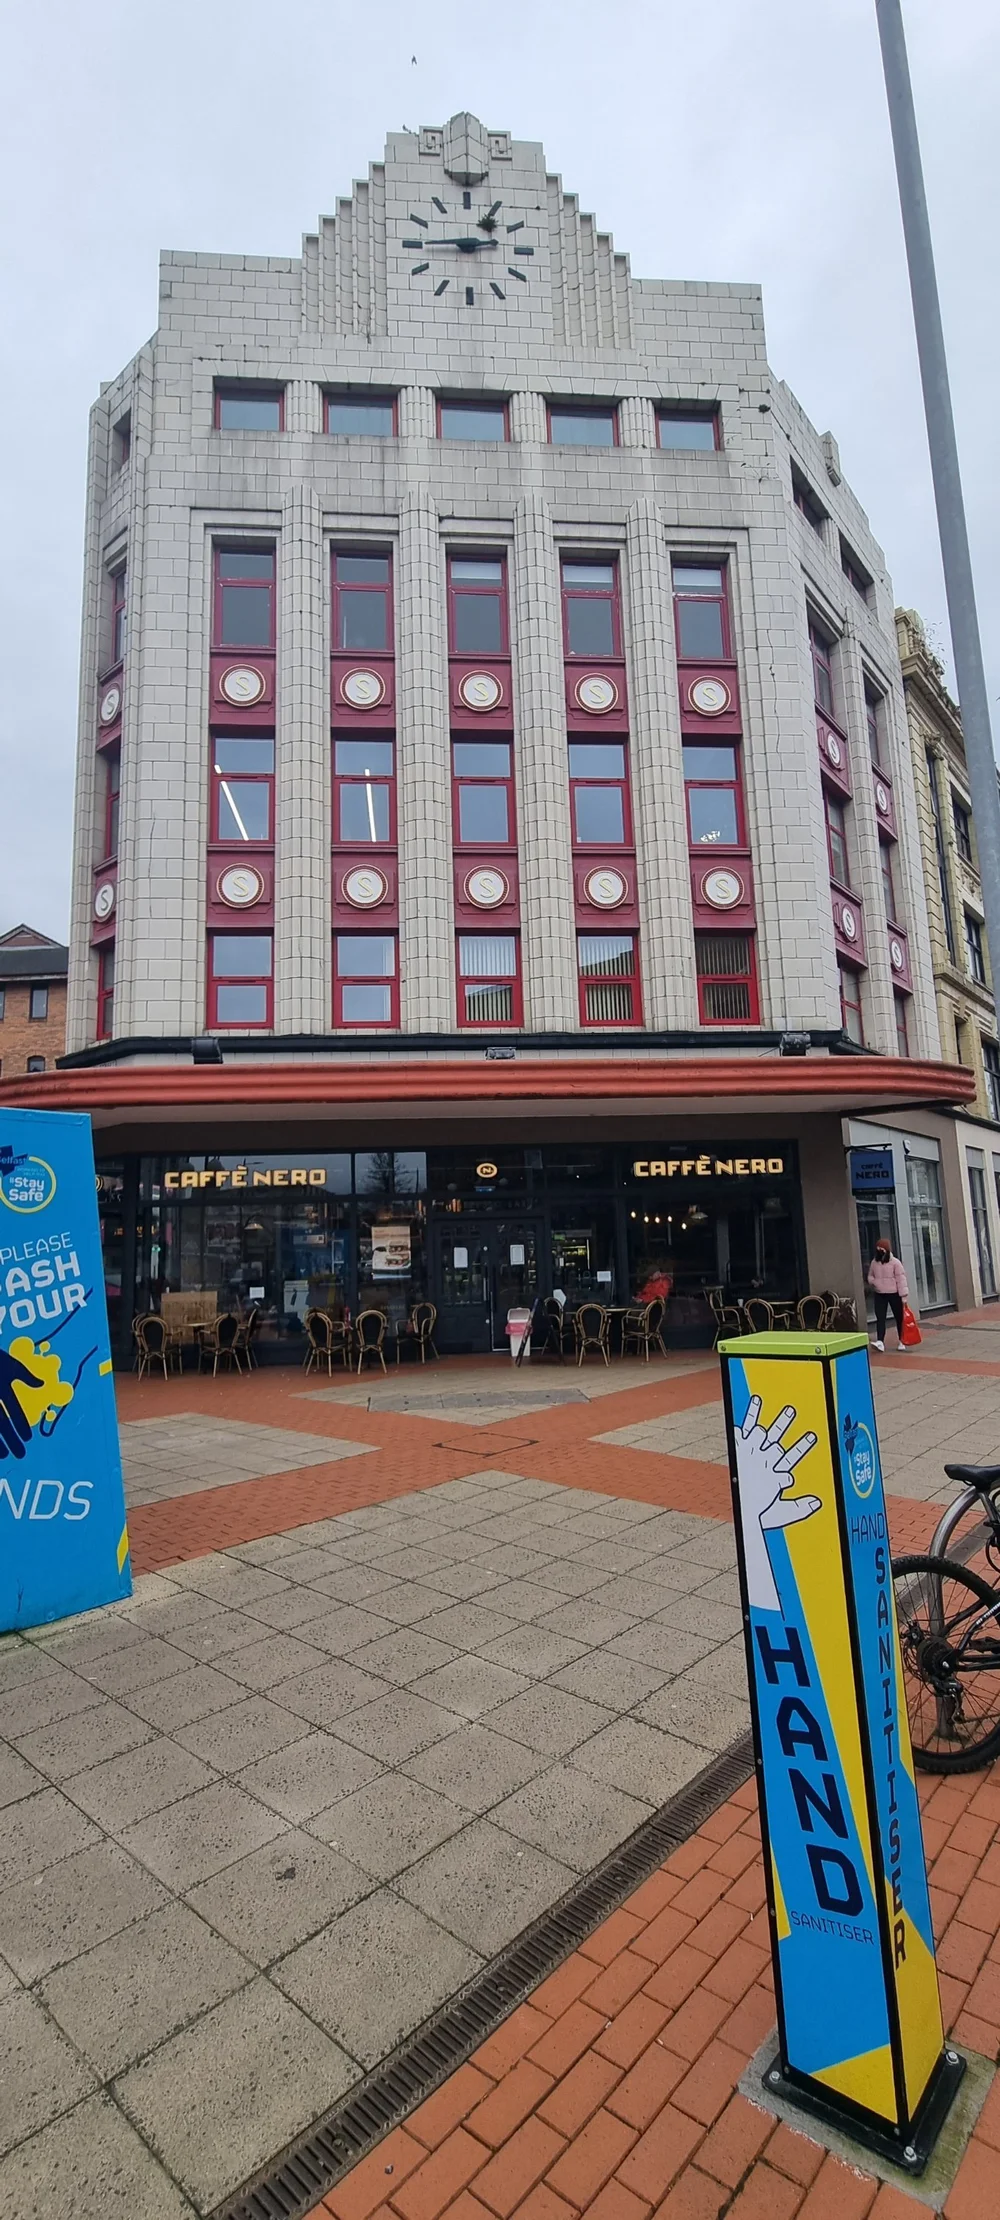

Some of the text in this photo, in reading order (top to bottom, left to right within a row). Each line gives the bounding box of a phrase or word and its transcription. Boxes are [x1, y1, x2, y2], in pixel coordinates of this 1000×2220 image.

[0, 1155, 26, 1165] elfast
[634, 1155, 783, 1177] CAFFÈ NERO
[164, 1165, 327, 1188] CAFFÈ NERO
[856, 1170, 889, 1179] NERO
[9, 1189, 43, 1202] Safe
[0, 1232, 73, 1265] PLEASE
[0, 1251, 80, 1298] ASH
[855, 1465, 872, 1486] Safe
[851, 1512, 885, 1544] HAND
[754, 1625, 864, 1917] HAND
[874, 1547, 906, 1969] SANITISER
[790, 1911, 875, 1945] SANITISER
